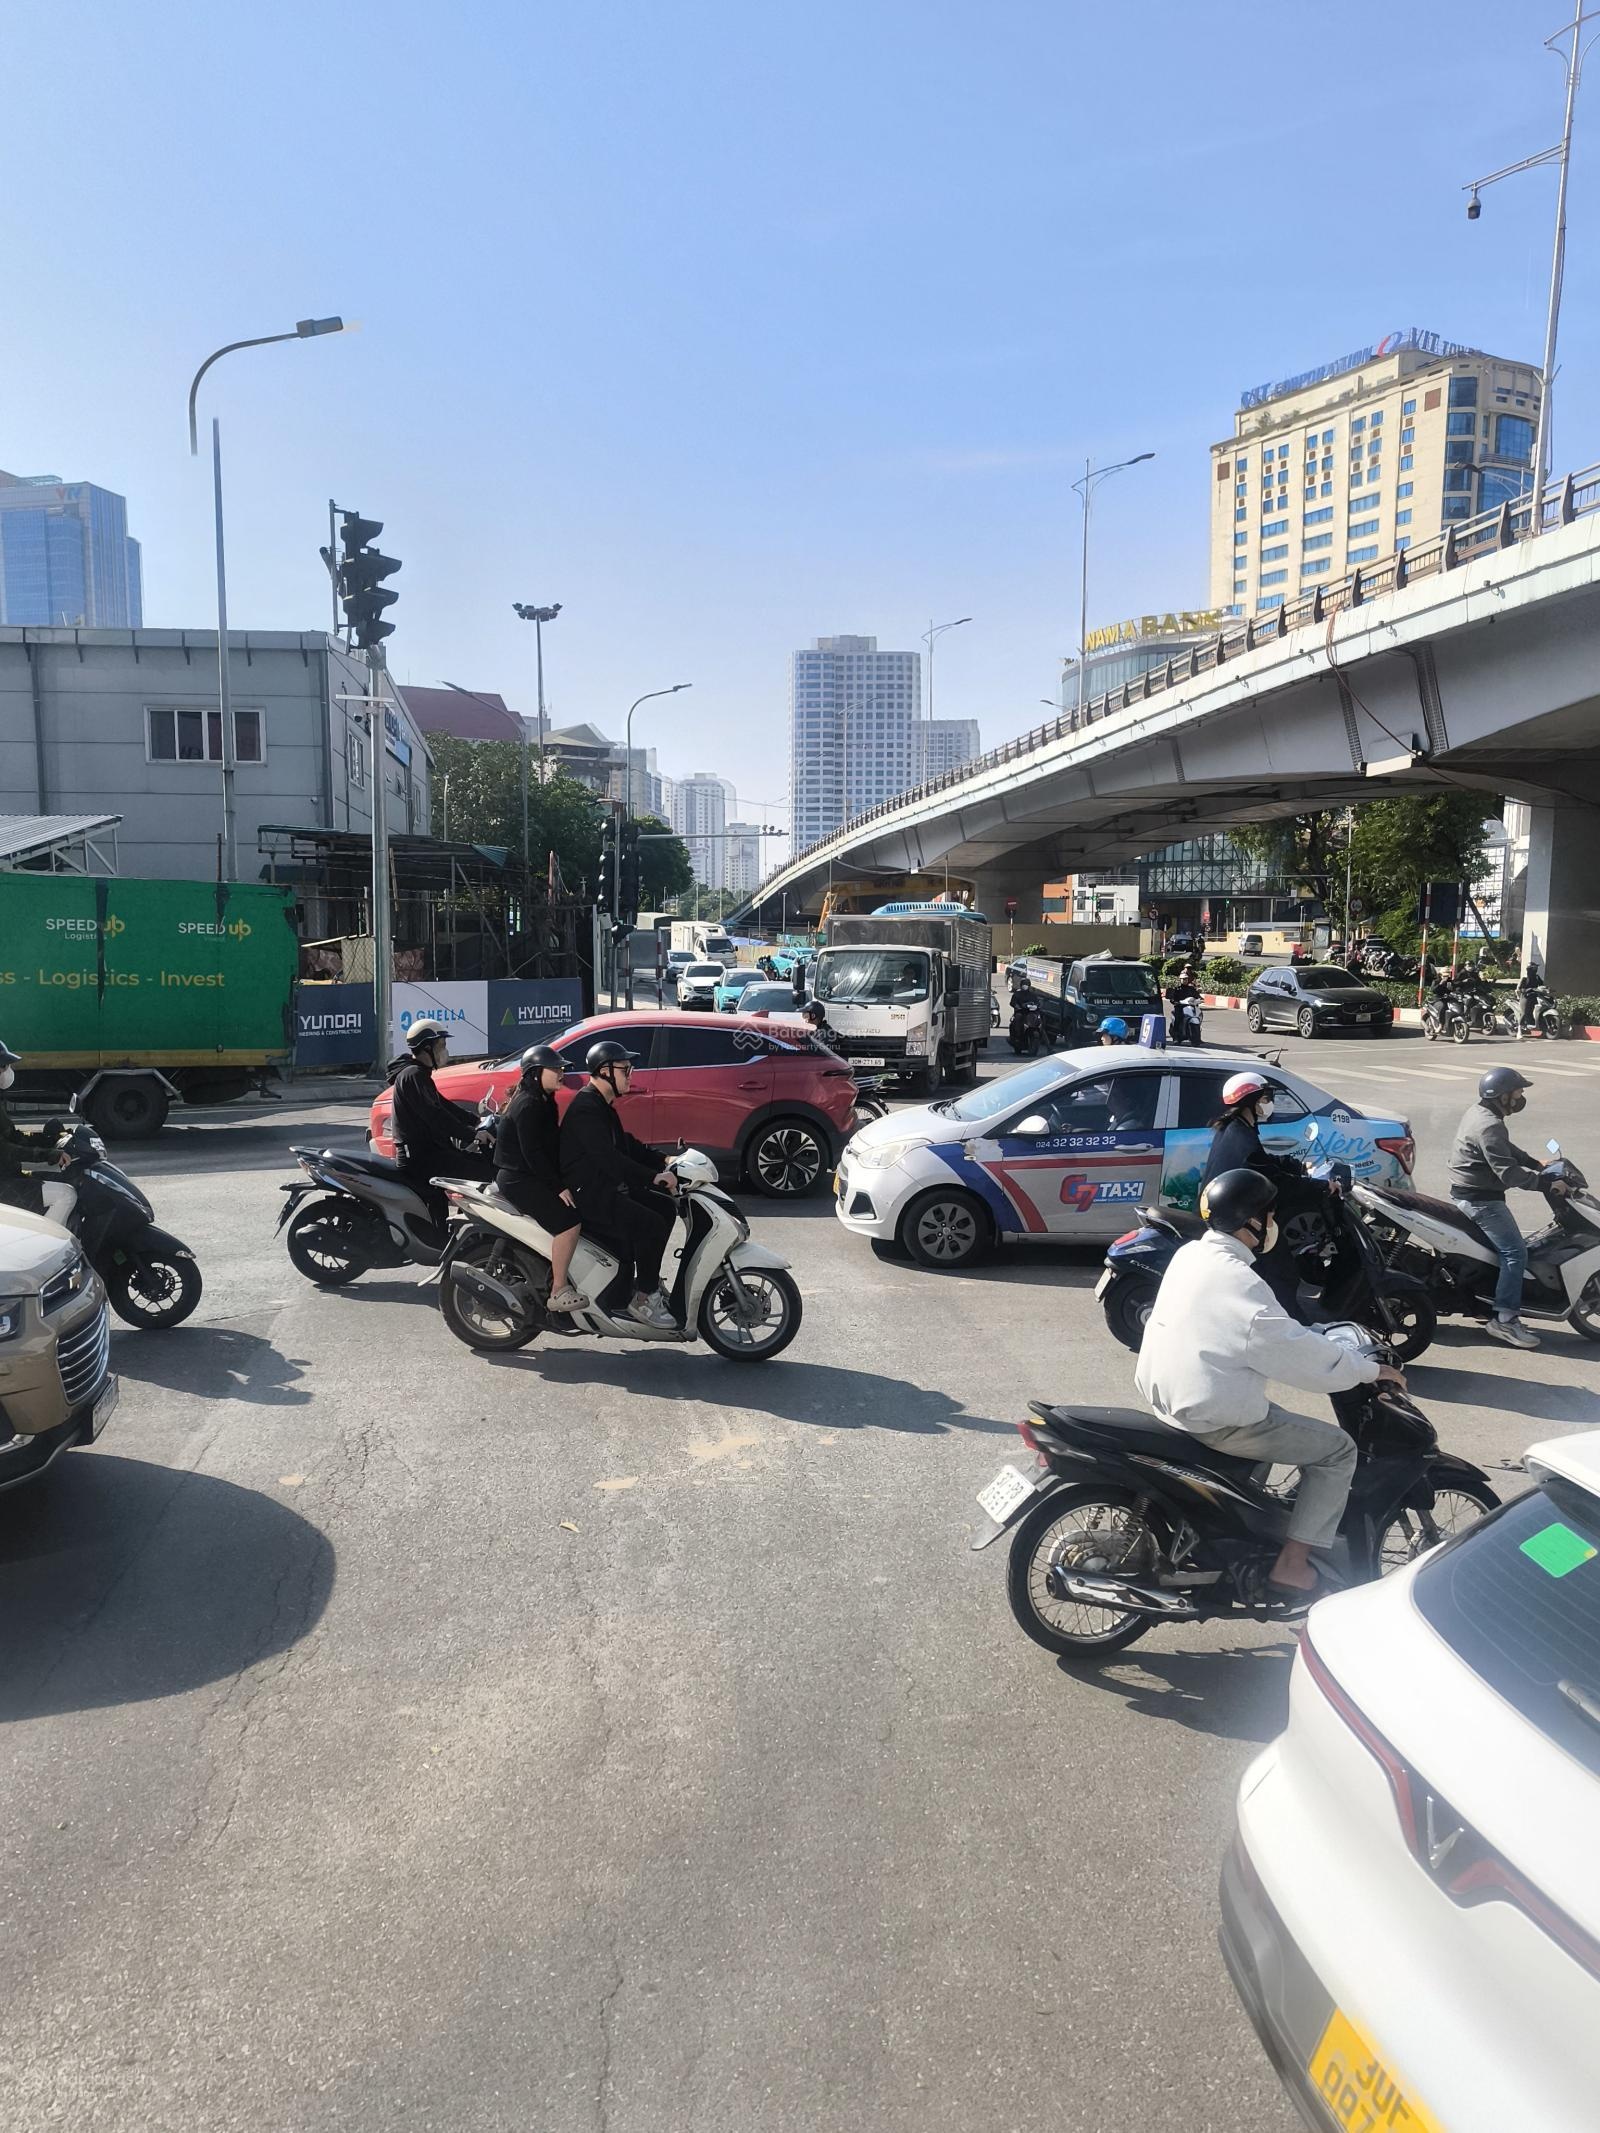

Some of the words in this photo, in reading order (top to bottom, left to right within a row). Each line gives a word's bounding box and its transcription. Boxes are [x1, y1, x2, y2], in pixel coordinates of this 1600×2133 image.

[1085, 623, 1121, 651] NAM
[1141, 611, 1221, 635] BANK
[161, 970, 225, 987] Invest
[416, 1008, 466, 1022] GHELLA
[518, 1004, 572, 1020] HYUNDAI
[300, 1013, 362, 1030] YUNDAI
[1052, 1138, 1067, 1148] 32
[1069, 1137, 1083, 1147] 32
[1085, 1136, 1100, 1146] 32
[1102, 1135, 1116, 1145] 32
[1099, 1182, 1145, 1198] TAXI
